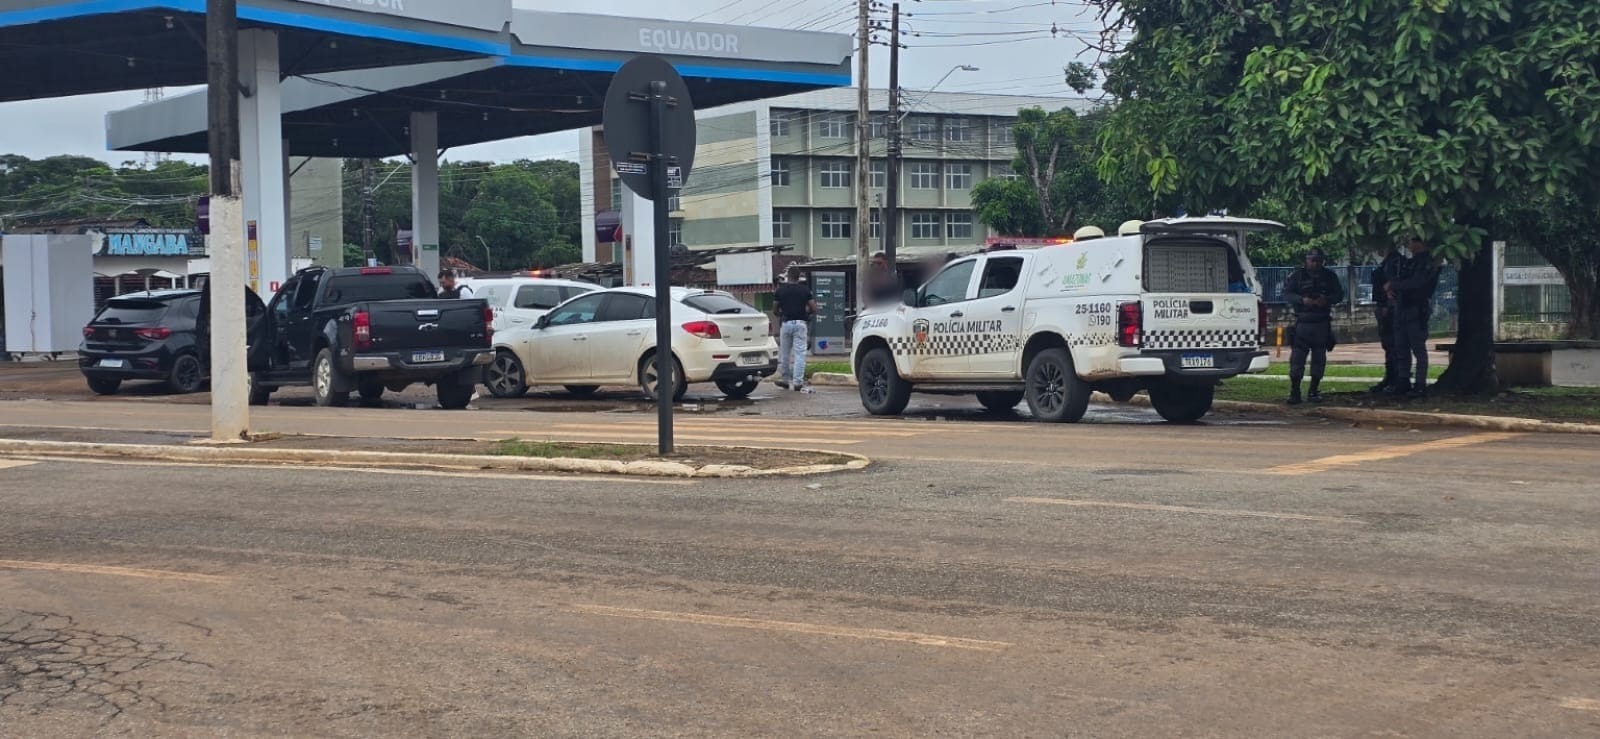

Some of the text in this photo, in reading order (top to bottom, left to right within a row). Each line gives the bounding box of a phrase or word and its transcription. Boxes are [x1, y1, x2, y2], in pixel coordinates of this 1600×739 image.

[639, 28, 739, 53] EQUADOR
[108, 234, 189, 255] MANGABA
[1075, 303, 1111, 314] 25-1160
[1153, 298, 1188, 309] POLÍCIA
[1154, 309, 1188, 319] MILITAR
[862, 319, 888, 330] 25-1160
[1097, 315, 1111, 326] 190
[933, 320, 1002, 333] POLÍCIA MILITAR
